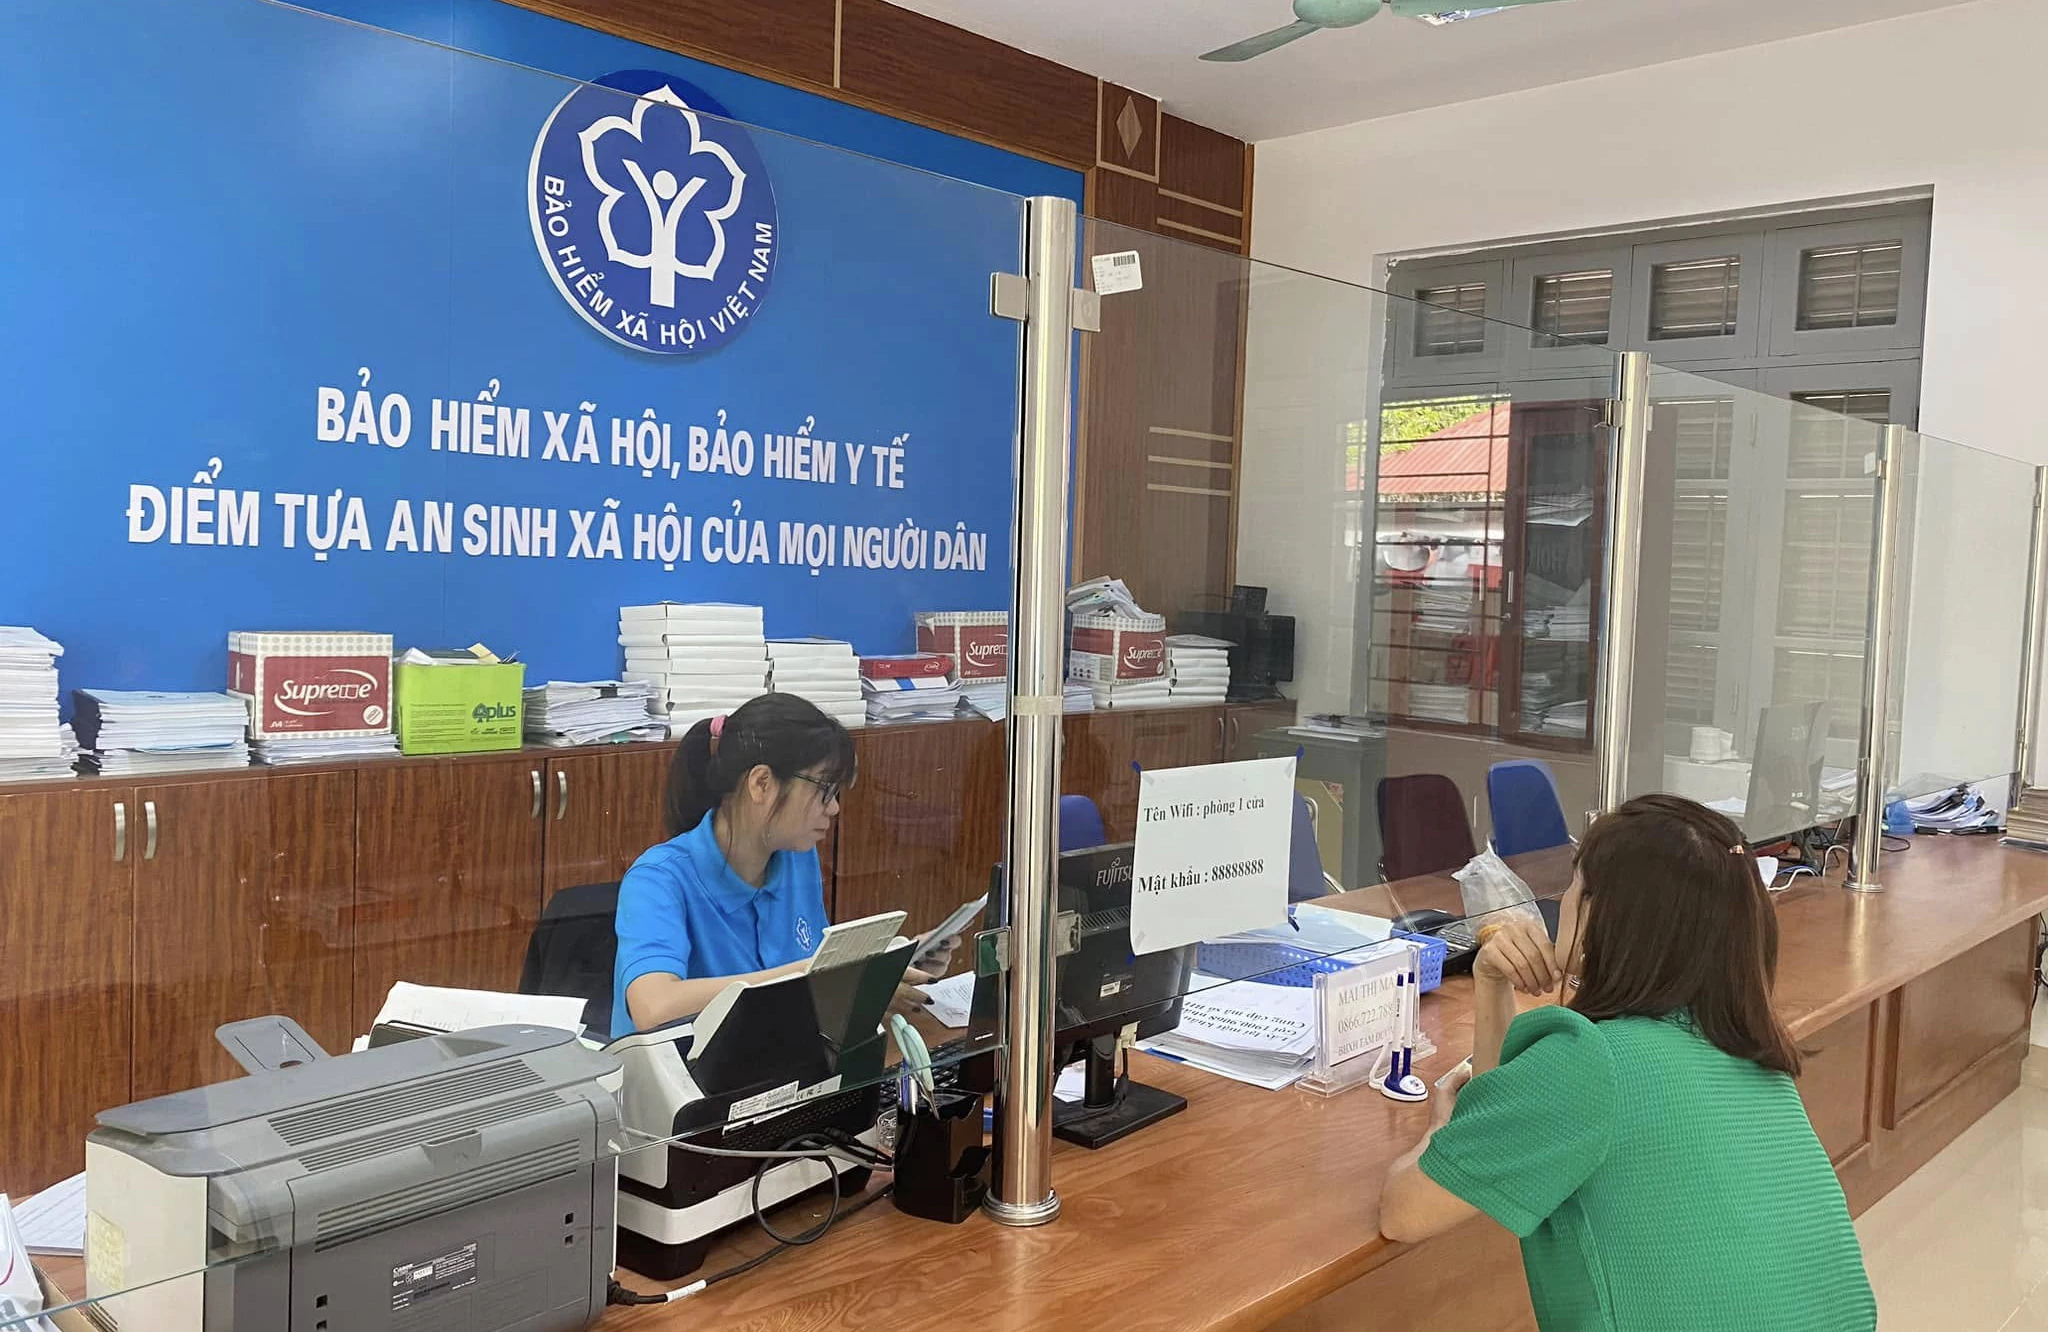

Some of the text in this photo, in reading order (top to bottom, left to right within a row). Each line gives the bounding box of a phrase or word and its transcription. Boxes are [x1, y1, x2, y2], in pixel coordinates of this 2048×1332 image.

[544, 174, 773, 349] BẢO HIỂM XÃ HỘI VIỆT NAM
[317, 366, 911, 489] BẢO HIỂM XÃ HỘI, BẢO HIỂM Y TẾ
[126, 456, 987, 576] ĐIỂM TỰA AN SINH XÃ HỘI CỦA MỌI NGƯỜI DÂN
[1143, 806, 1166, 822] Tên
[1170, 803, 1193, 819] Wifi
[1203, 799, 1235, 819] phòng
[1138, 874, 1166, 895] Mật
[1171, 865, 1200, 889] khẩu
[1211, 858, 1264, 881] 88888888
